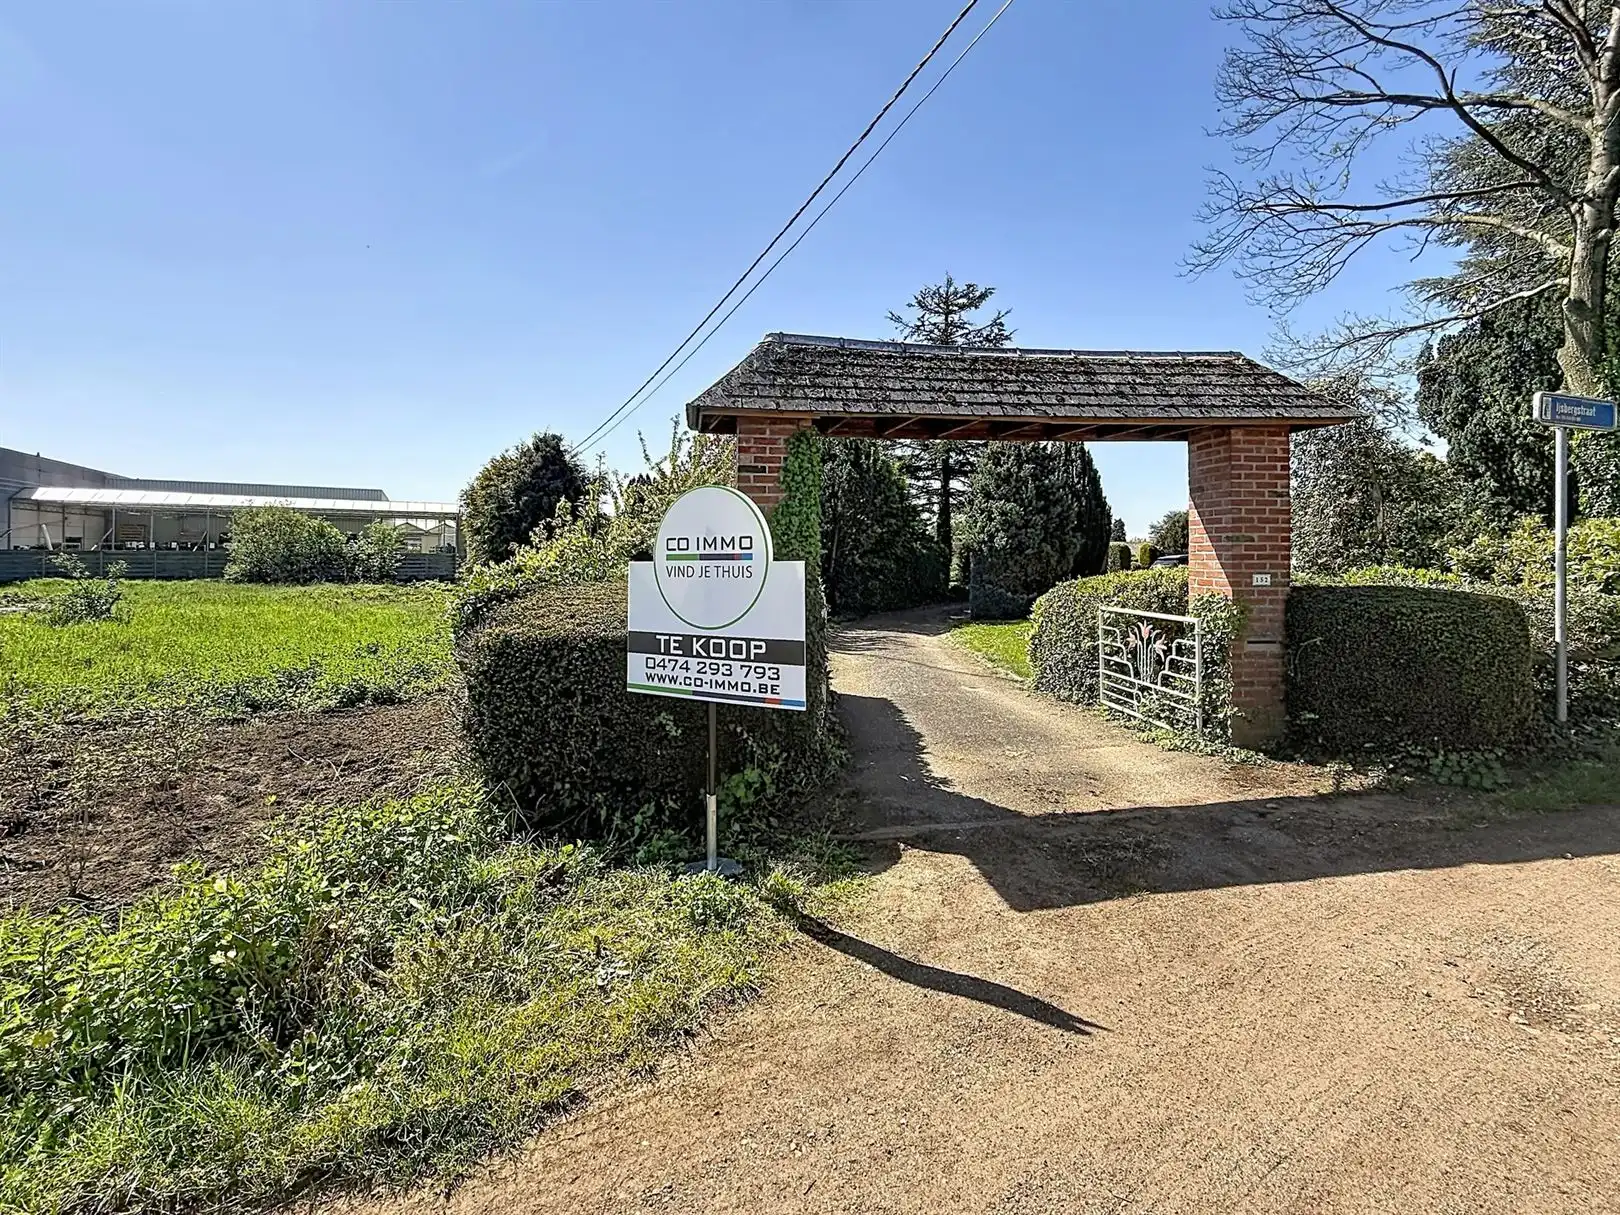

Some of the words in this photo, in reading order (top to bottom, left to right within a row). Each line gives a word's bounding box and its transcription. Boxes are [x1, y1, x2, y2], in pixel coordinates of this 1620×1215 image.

[666, 537, 689, 551] CO
[696, 535, 753, 551] IMMO
[666, 565, 695, 578] VIND
[698, 565, 711, 578] JE
[714, 565, 753, 579] THUIS
[656, 635, 683, 655] TE
[692, 637, 767, 660] KOOP
[645, 656, 691, 673] 0474
[696, 660, 733, 677] 293
[740, 664, 780, 681] 793
[645, 672, 780, 696] WWW.CO-IMMO.BE
